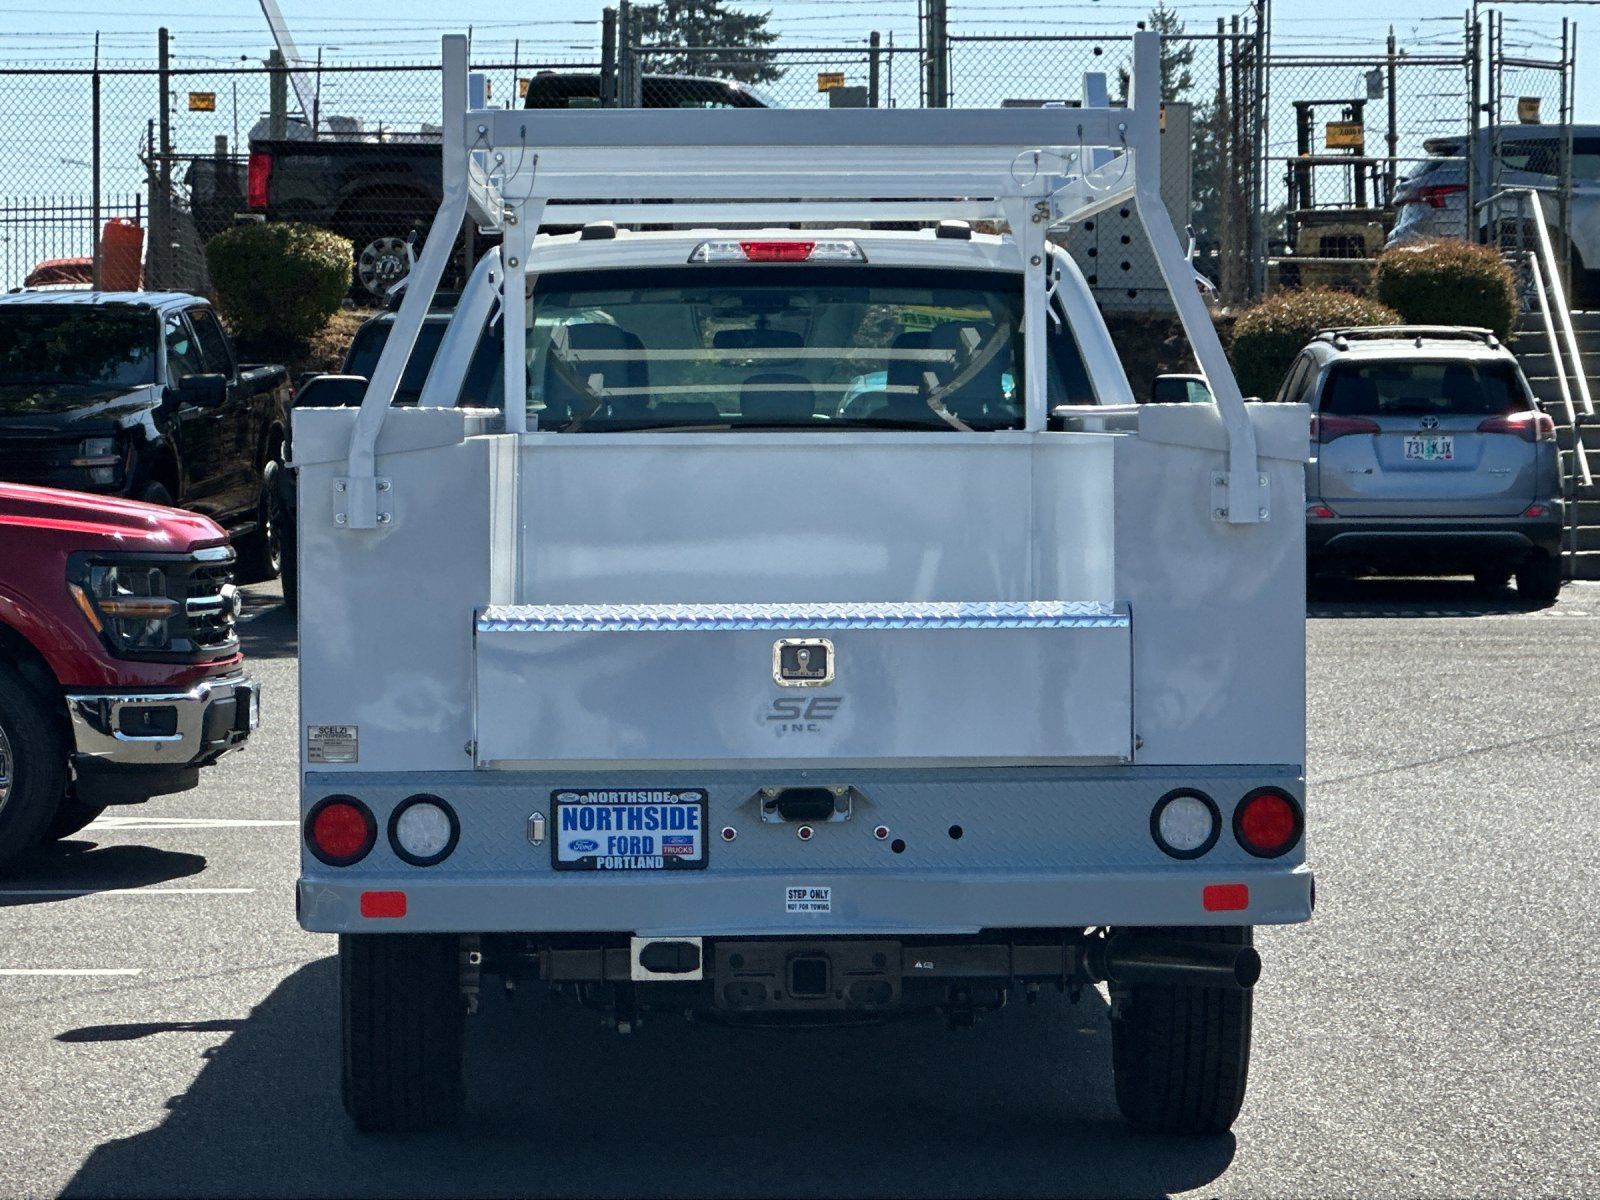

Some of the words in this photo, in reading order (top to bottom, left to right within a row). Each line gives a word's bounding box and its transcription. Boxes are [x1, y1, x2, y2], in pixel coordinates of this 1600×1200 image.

[1406, 441, 1424, 455] 731
[1432, 441, 1451, 455] KJX
[766, 697, 843, 720] SE
[318, 726, 348, 734] SCELZI
[782, 724, 820, 732] INC.
[588, 791, 671, 803] NORTHSIDE
[562, 806, 699, 831] NORTHSIDE
[607, 835, 654, 855] FORD
[663, 846, 693, 854] TRUCKS
[596, 856, 664, 869] PORTLAND
[788, 889, 807, 899] STEP
[810, 889, 829, 899] ONLY
[810, 903, 830, 911] TOWING
